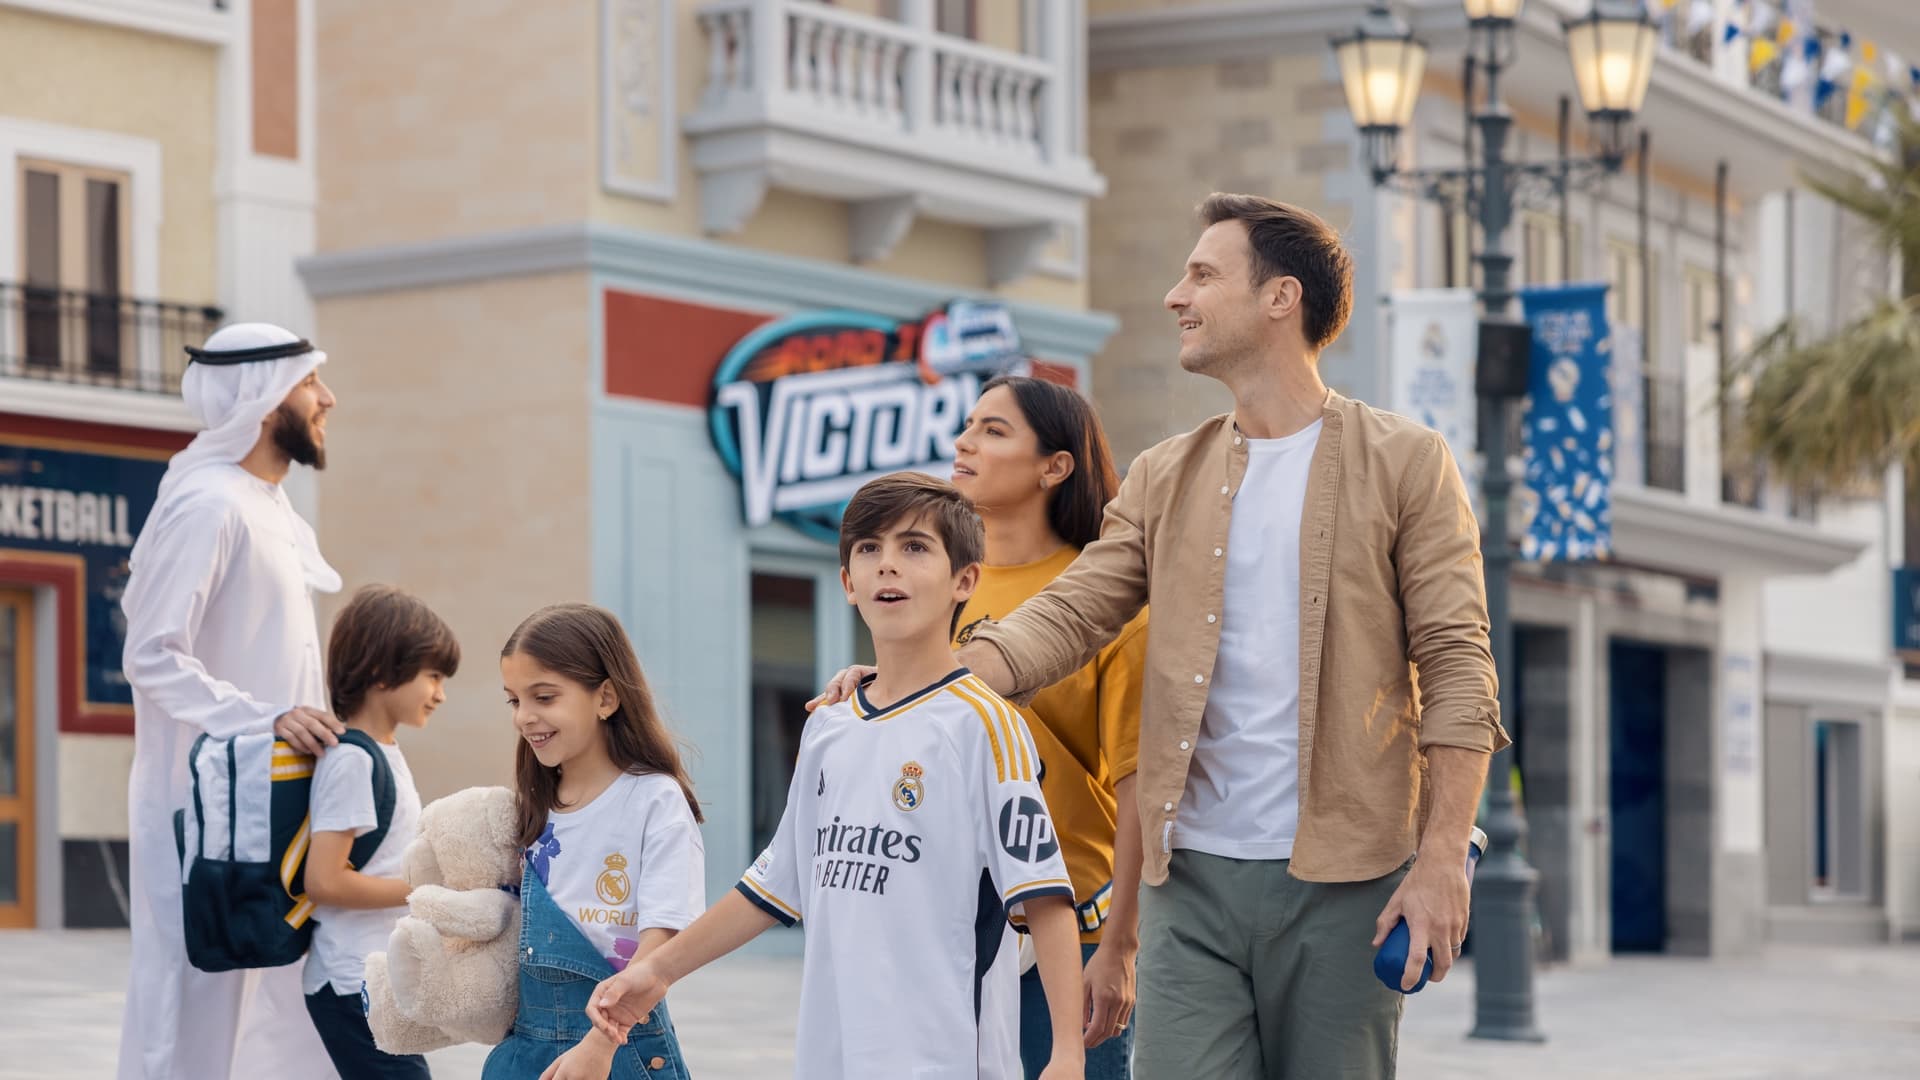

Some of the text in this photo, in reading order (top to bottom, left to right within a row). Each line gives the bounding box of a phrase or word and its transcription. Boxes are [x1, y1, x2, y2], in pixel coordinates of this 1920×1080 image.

[813, 816, 922, 863] mirates
[1004, 795, 1053, 863] hp
[821, 859, 890, 895] BETTER
